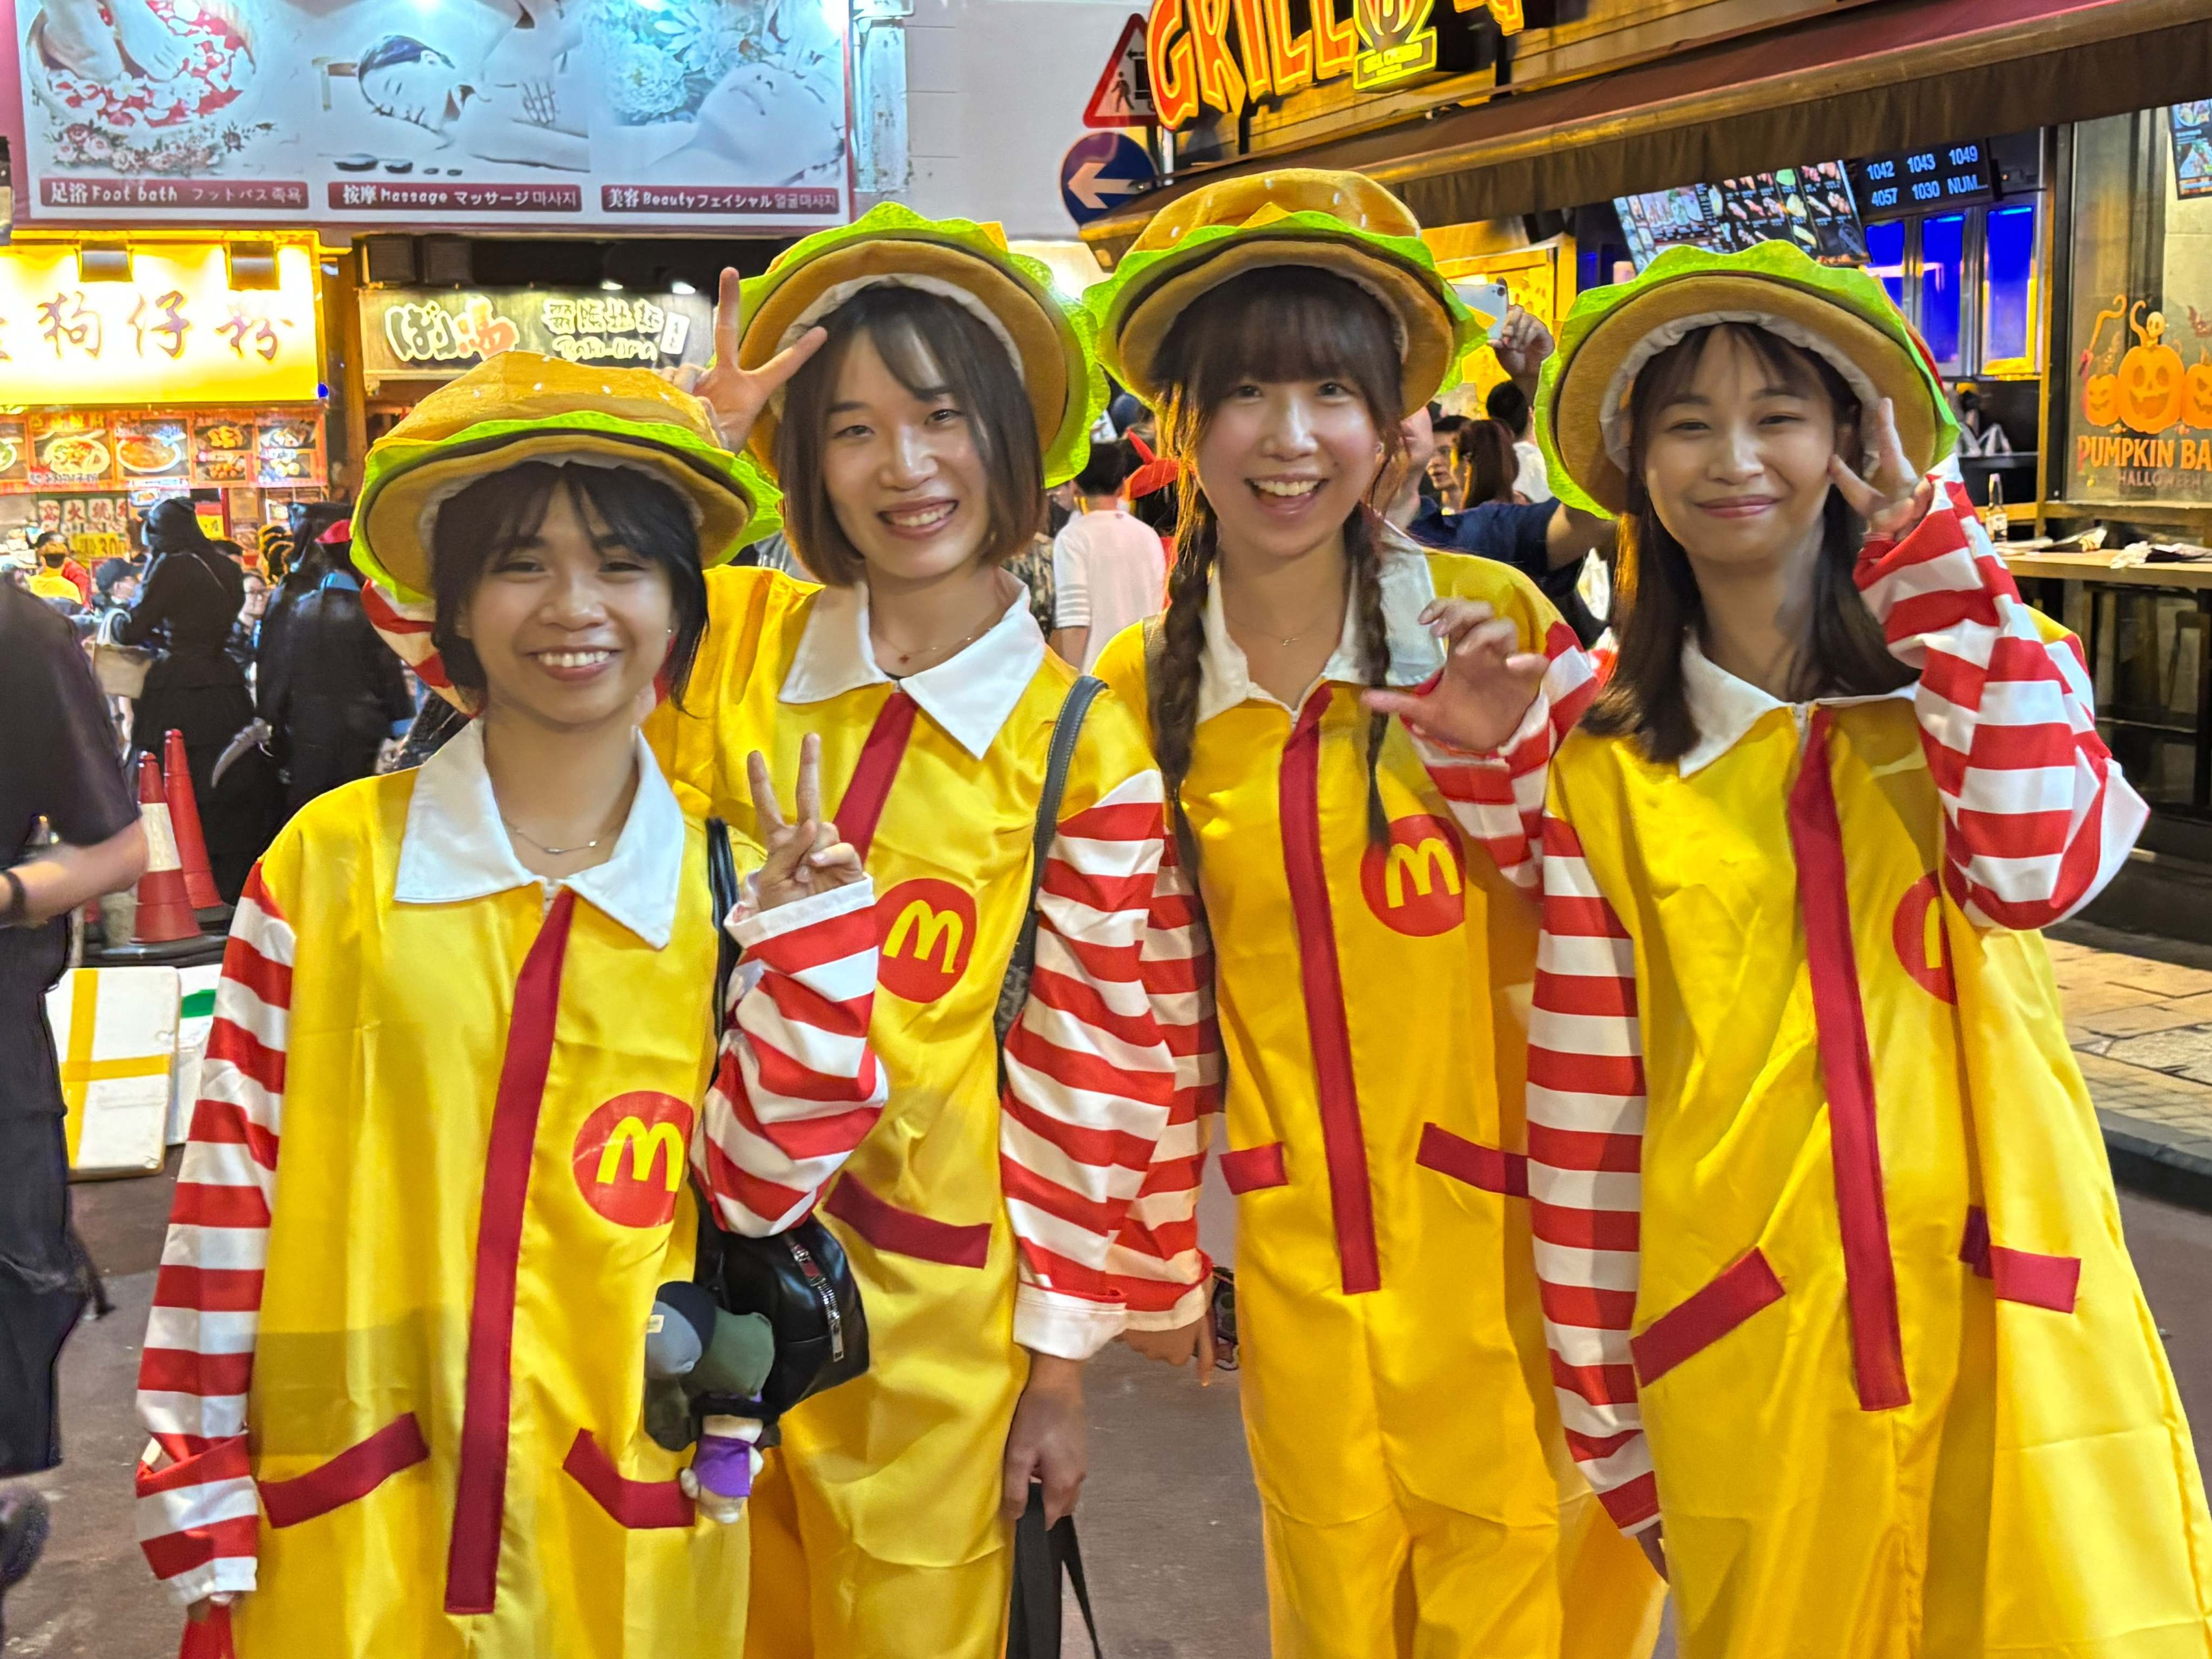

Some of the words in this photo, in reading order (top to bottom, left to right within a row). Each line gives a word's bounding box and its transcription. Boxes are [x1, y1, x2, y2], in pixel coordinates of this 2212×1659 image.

[1866, 160, 1896, 180] 1042
[1907, 153, 1936, 173] 1043
[1948, 145, 1978, 166] 1049
[51, 181, 87, 204] 足浴
[92, 185, 131, 203] Foot
[138, 185, 178, 203] bath
[343, 184, 377, 206] 按摩
[381, 187, 448, 206] Massage
[454, 191, 530, 206] マッサージ
[532, 190, 577, 207] 마사지
[609, 188, 640, 208] 美容
[643, 192, 695, 208] Beauty
[697, 194, 772, 208] フェイシャル
[1871, 187, 1898, 207] 4057
[1912, 180, 1940, 200] 1030
[0, 290, 295, 361] 狗仔粉
[2077, 435, 2175, 469] PUMPKIN
[2117, 470, 2202, 488] HALLOWEEN
